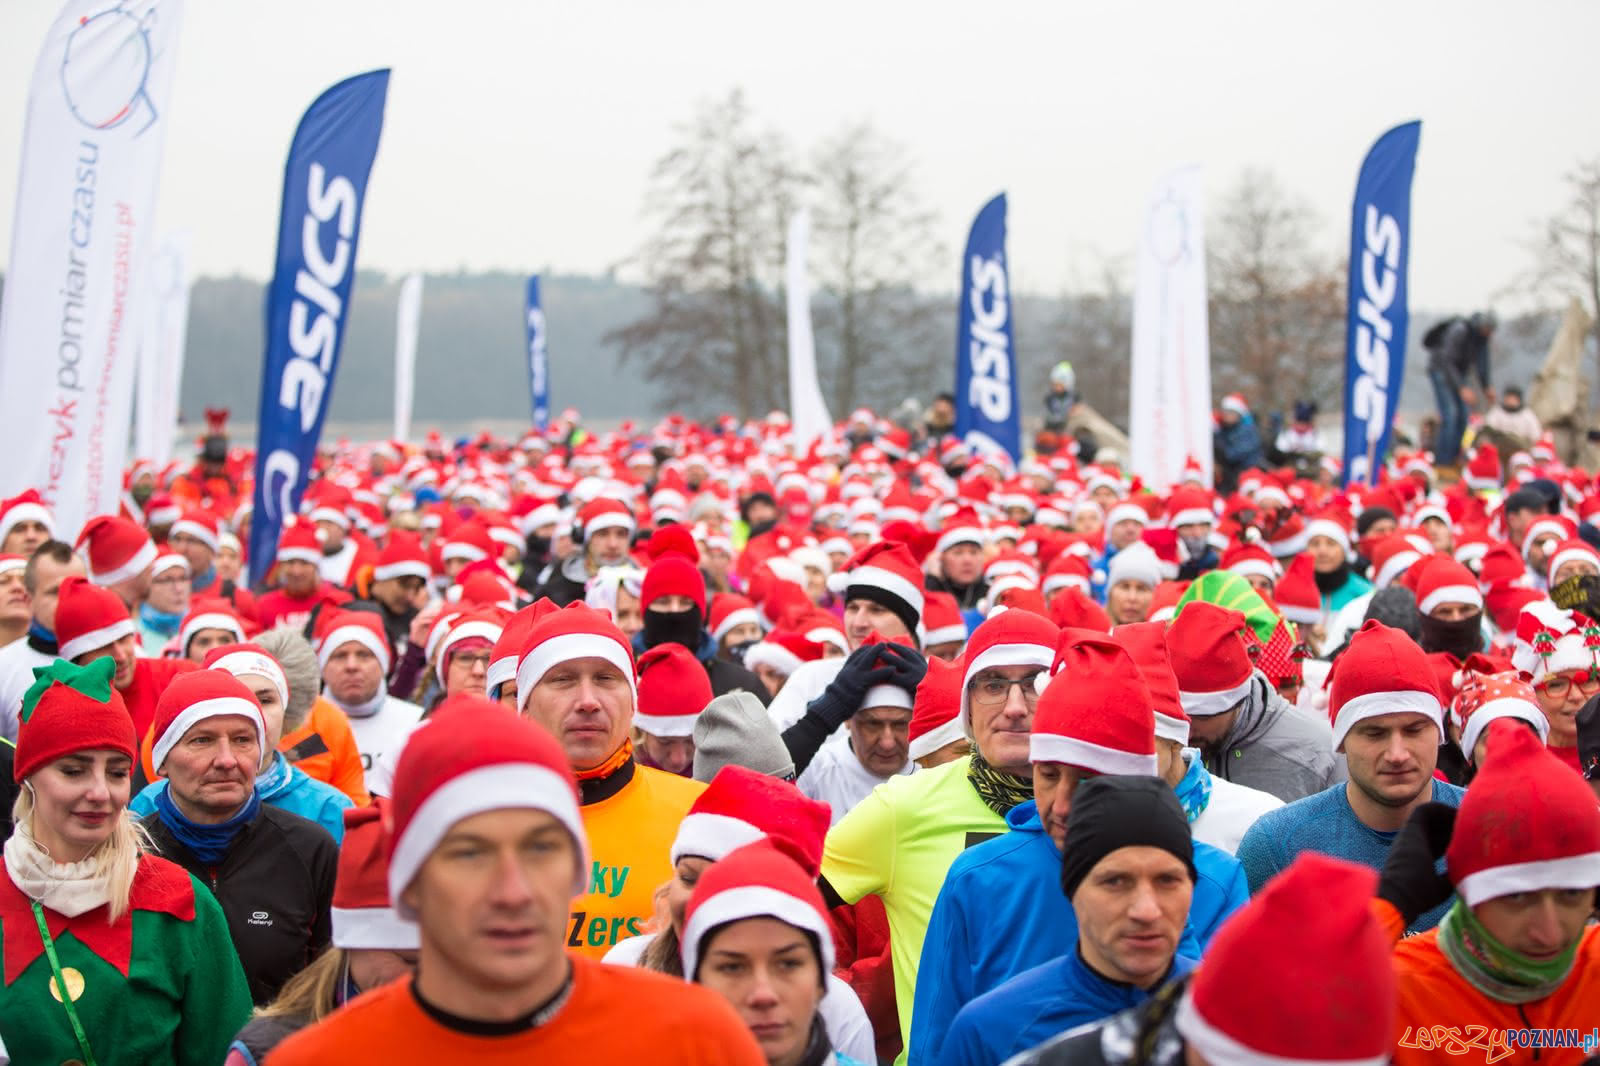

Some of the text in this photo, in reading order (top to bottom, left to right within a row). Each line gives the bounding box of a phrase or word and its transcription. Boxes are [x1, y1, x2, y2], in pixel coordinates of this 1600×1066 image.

[280, 162, 357, 433] asics
[968, 253, 1012, 423] asics
[1353, 203, 1401, 443] asics
[589, 861, 630, 898] ky
